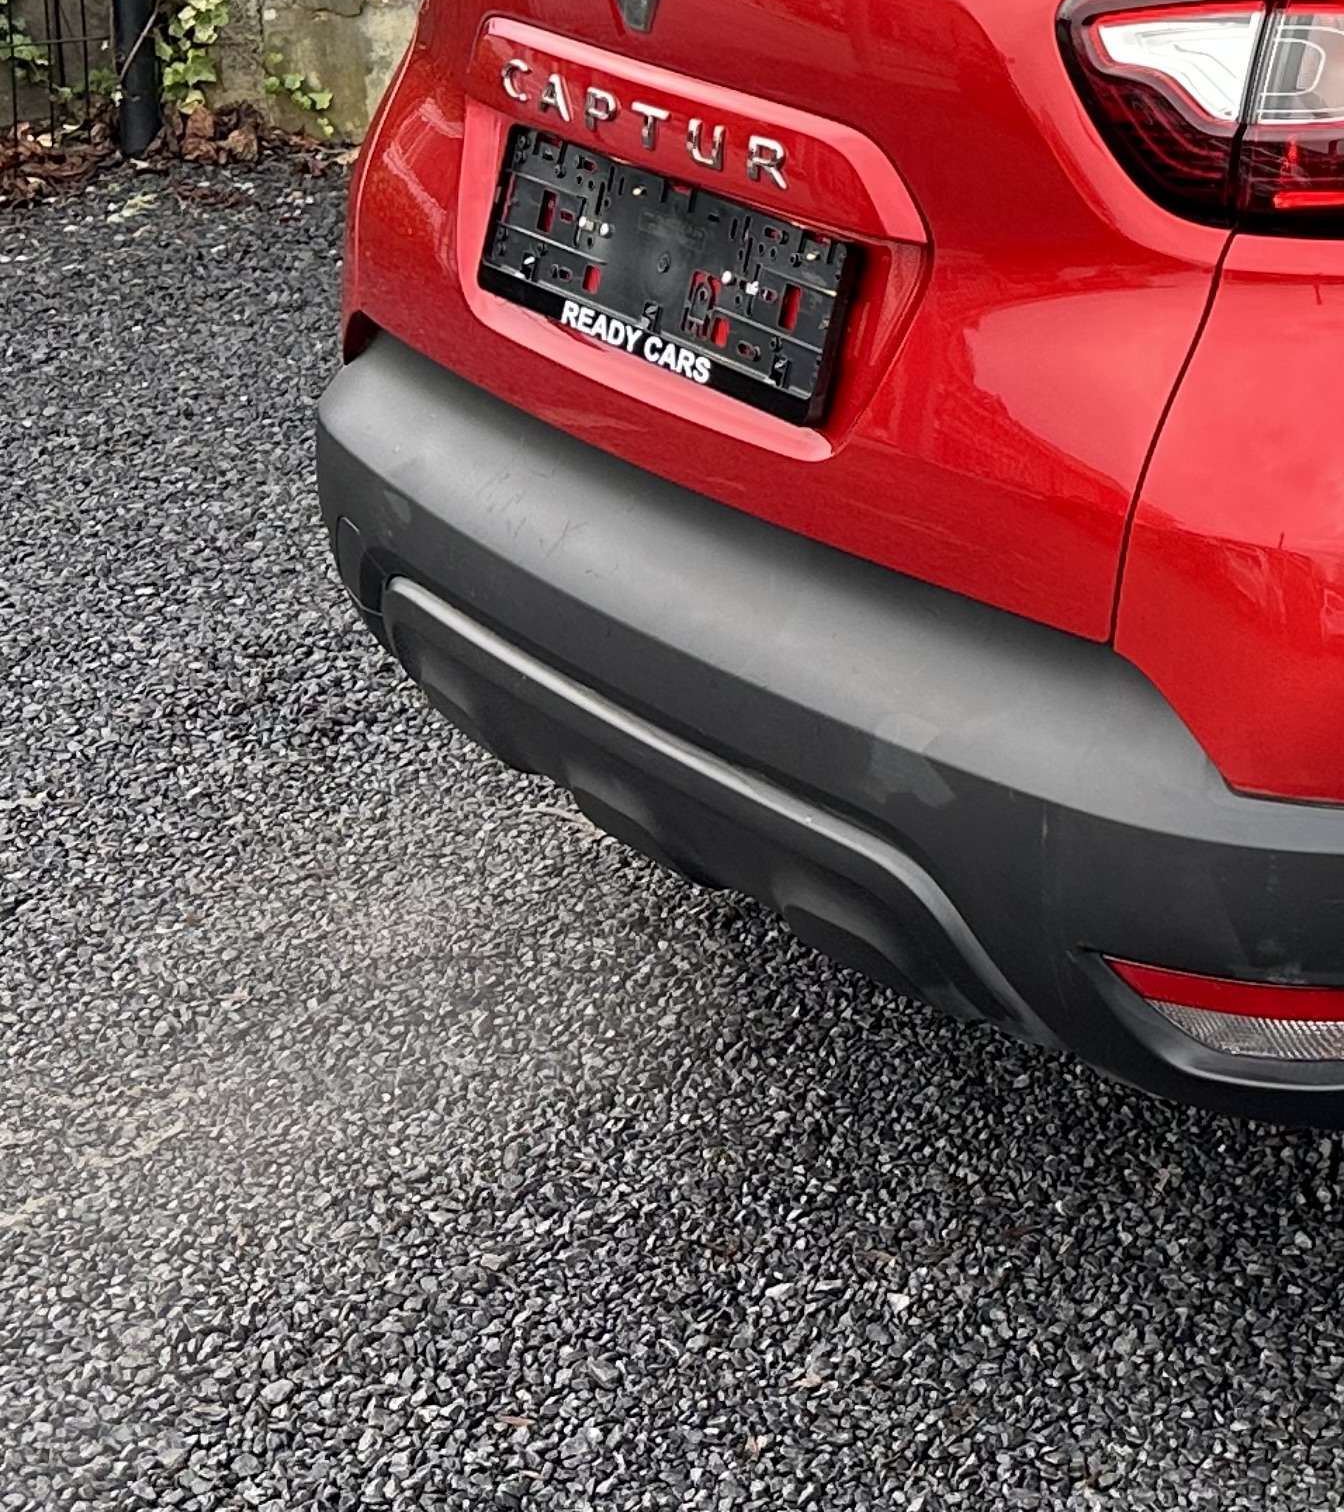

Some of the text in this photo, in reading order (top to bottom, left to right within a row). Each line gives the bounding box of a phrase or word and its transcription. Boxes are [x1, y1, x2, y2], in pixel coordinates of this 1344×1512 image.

[501, 58, 789, 190] CAPTUR
[560, 300, 711, 384] READY CARS
